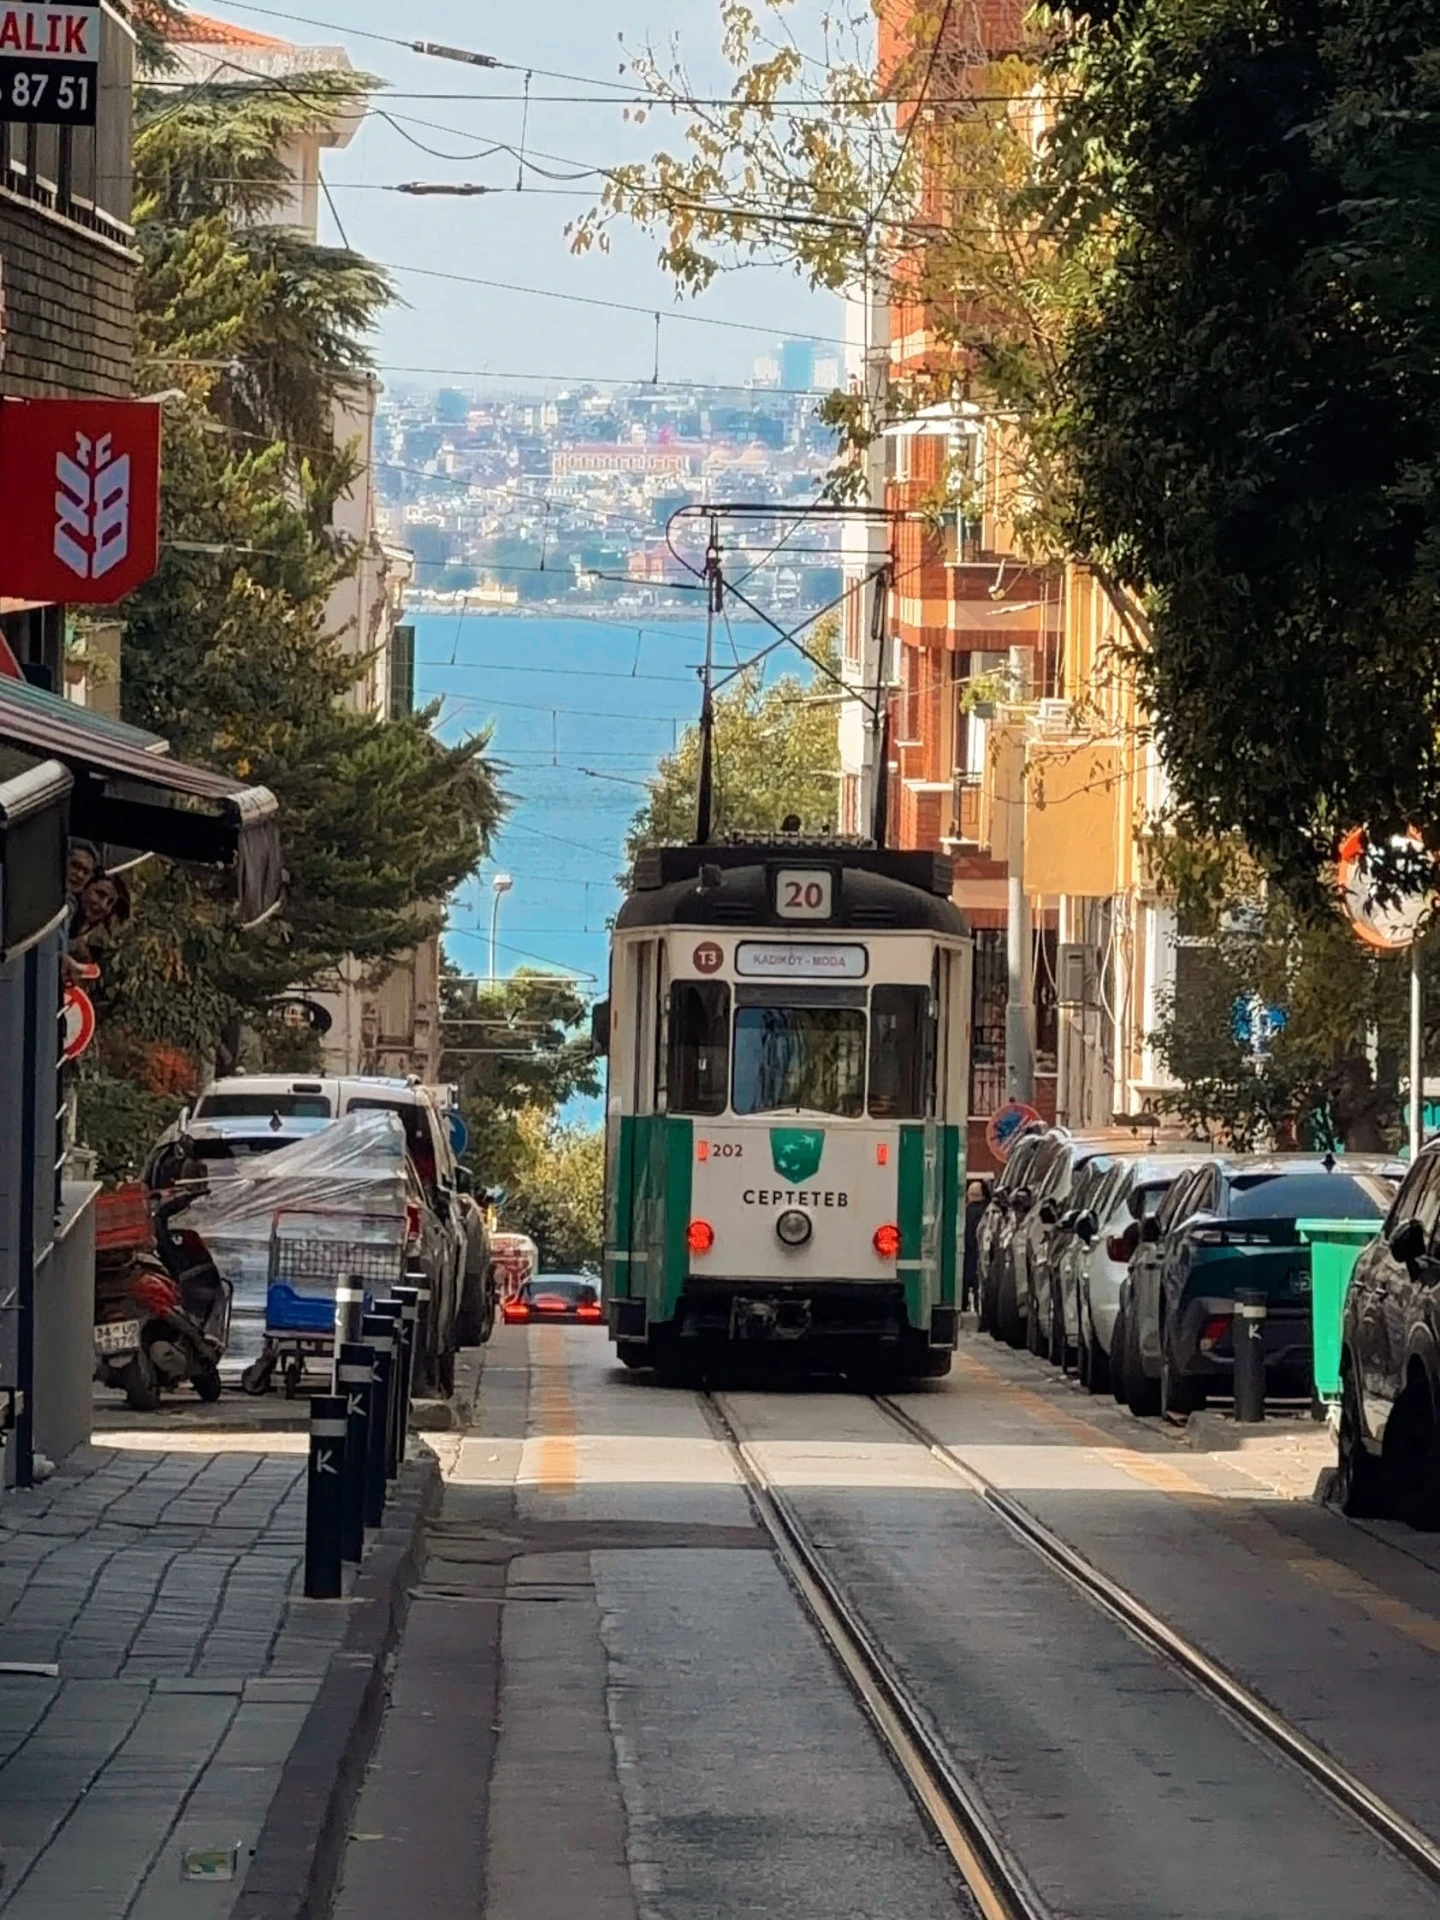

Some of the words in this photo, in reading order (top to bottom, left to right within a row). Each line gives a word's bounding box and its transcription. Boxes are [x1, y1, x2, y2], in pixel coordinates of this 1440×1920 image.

[12, 72, 49, 108] 87
[57, 75, 89, 111] 51
[785, 882, 823, 909] 20
[698, 950, 717, 966] T3
[812, 956, 846, 967] MODA
[713, 1144, 743, 1158] 202
[743, 1190, 849, 1207] CEPTETEB
[1249, 1323, 1263, 1340] K
[346, 1393, 367, 1416] K
[316, 1449, 338, 1475] K
